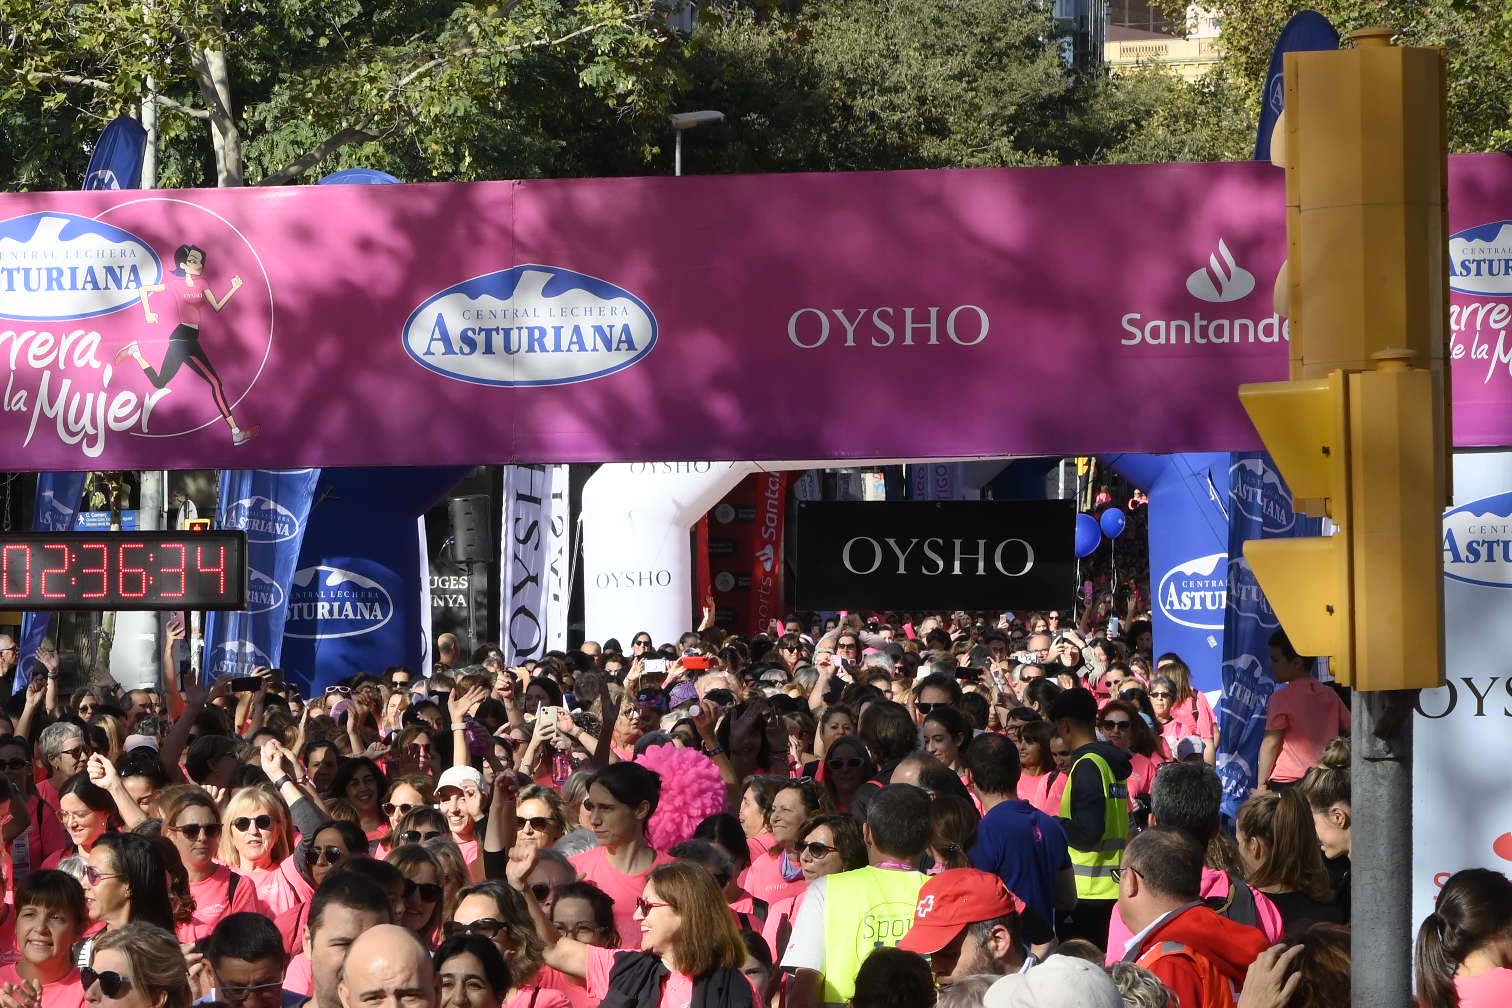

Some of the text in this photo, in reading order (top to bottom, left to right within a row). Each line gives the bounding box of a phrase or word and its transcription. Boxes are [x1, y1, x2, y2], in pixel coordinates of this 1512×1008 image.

[65, 246, 138, 260] LECHERA
[462, 305, 630, 321] CENTRAL LECHERA
[788, 304, 989, 348] OYSHO
[1120, 311, 1289, 346] Santand
[1450, 301, 1512, 331] arre
[423, 311, 638, 357] ASTURIANA
[1471, 332, 1489, 360] la
[3, 372, 28, 412] la
[22, 364, 172, 458] Mujer
[762, 471, 781, 541] Santa
[1468, 525, 1510, 535] CENT
[2, 542, 228, 599] 02:36:34
[509, 465, 545, 658] OYSH
[842, 536, 1035, 577] OYSHO
[596, 569, 672, 591] OYSHO
[285, 601, 384, 621] STURIANA
